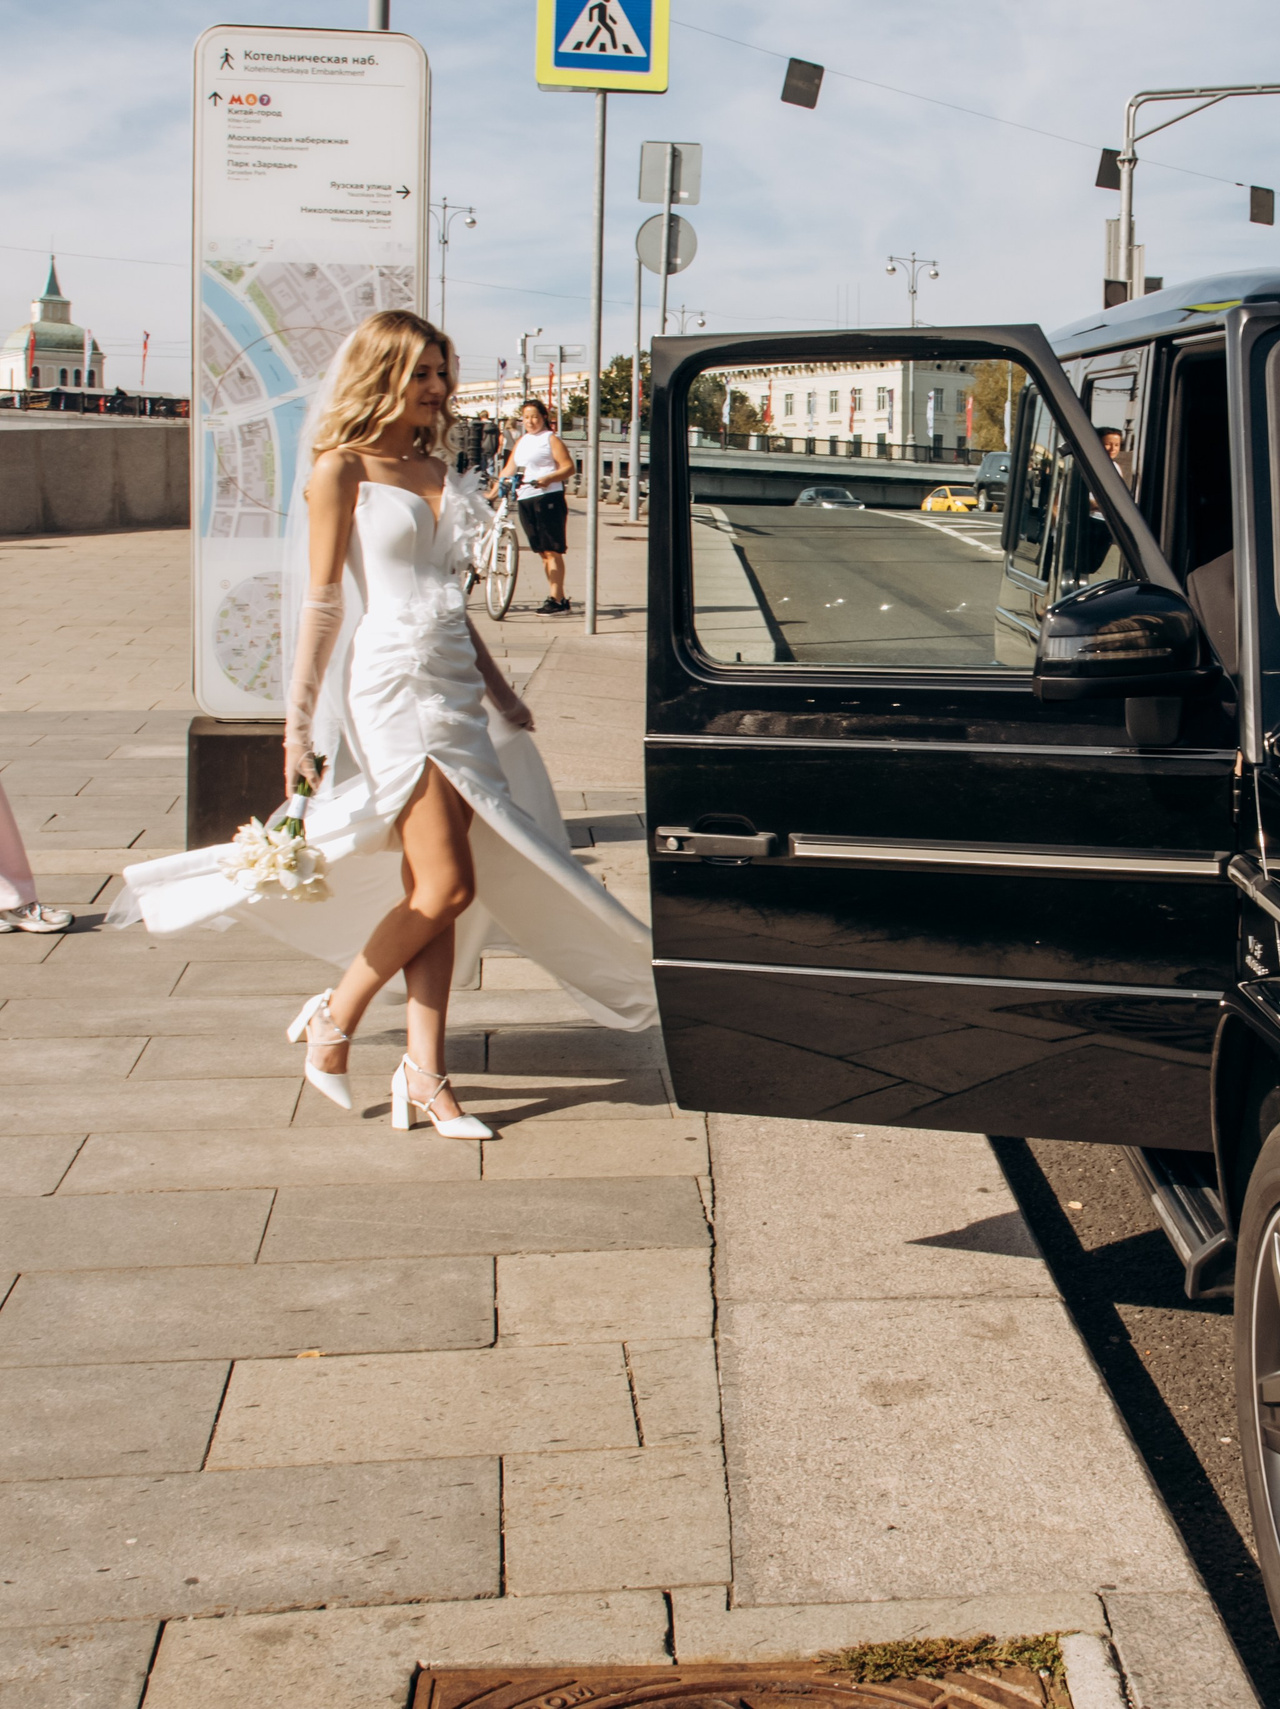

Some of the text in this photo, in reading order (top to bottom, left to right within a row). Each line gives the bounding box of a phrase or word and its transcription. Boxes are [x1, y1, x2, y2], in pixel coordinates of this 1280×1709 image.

[244, 50, 379, 66] Котельническая наб.
[311, 68, 365, 77] Embankment
[228, 109, 282, 117] Китай-город
[228, 134, 348, 145] Москворецкая набережная
[227, 160, 249, 168] Парк
[330, 181, 392, 191] Яузская улица
[300, 206, 392, 217] Николоямская улица
